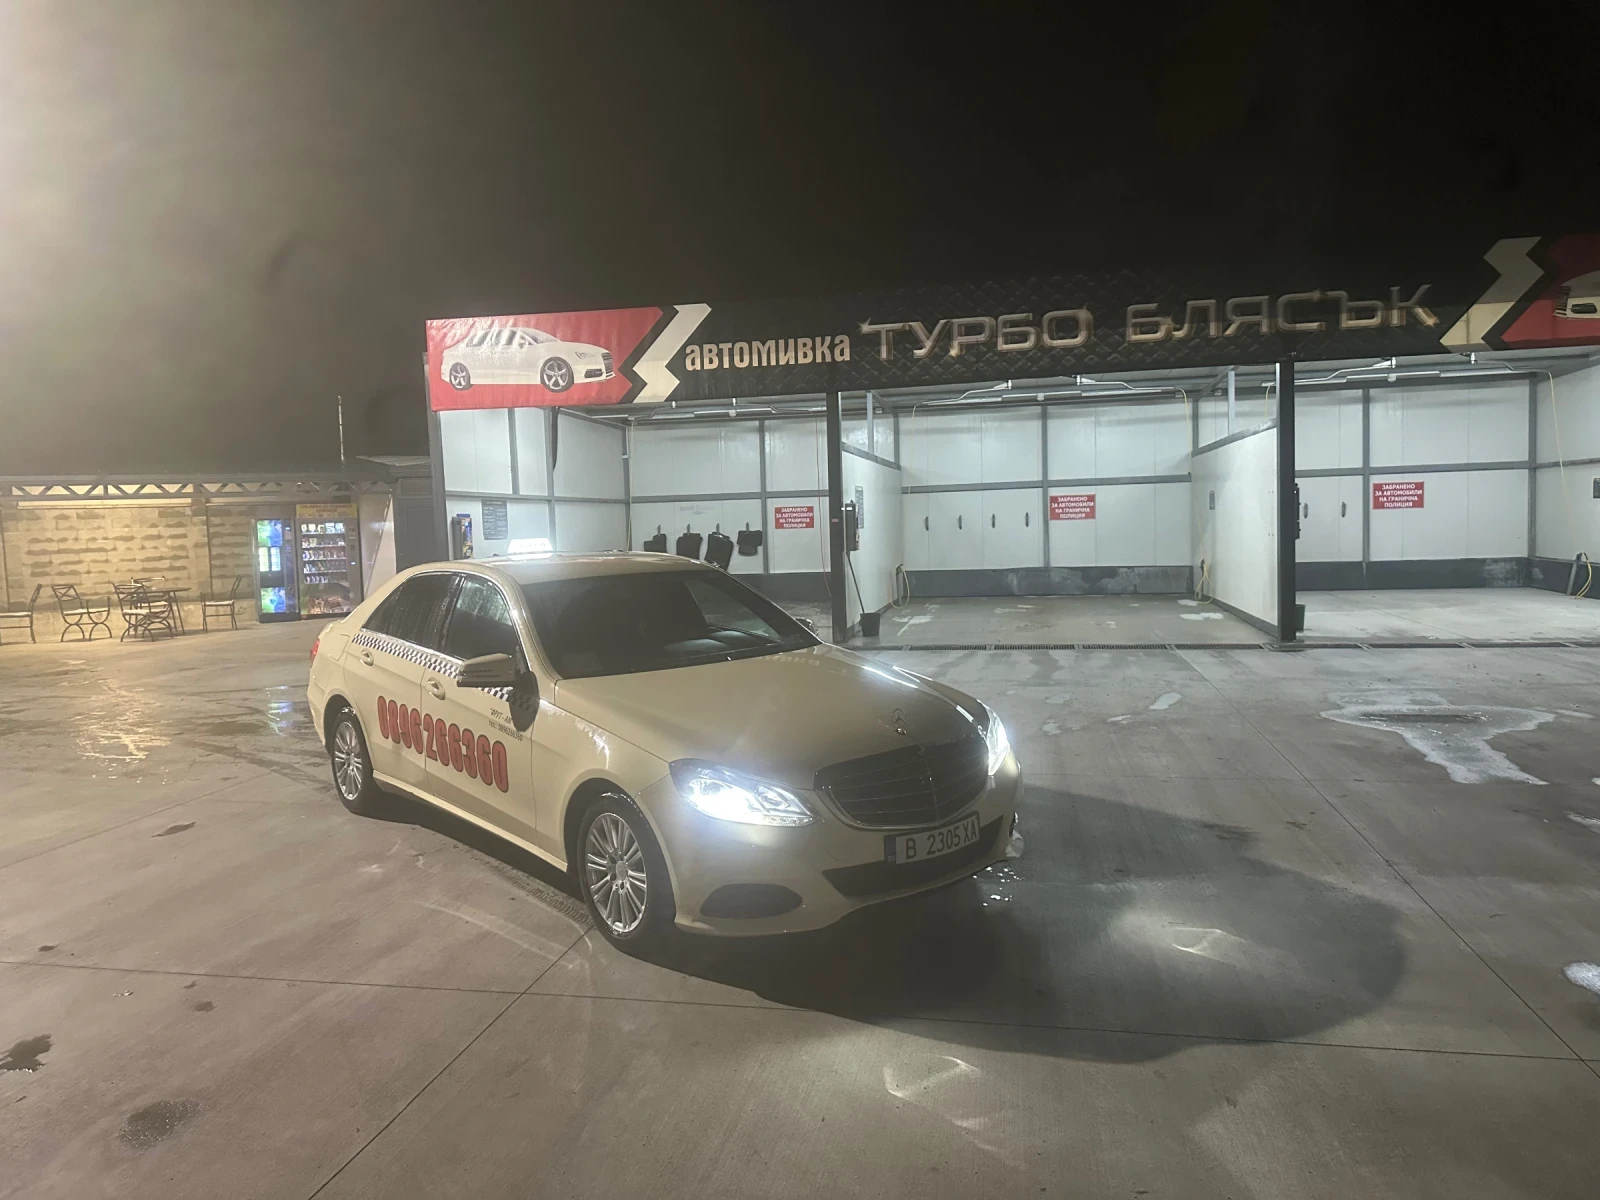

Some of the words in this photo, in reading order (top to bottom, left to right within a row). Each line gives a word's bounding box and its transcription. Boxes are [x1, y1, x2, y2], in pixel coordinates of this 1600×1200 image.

[685, 334, 850, 371] автомивка
[862, 308, 1094, 360] ТУРБО
[1126, 284, 1438, 344] БЛЯСЪК
[377, 695, 509, 793] 0896266360
[926, 826, 961, 856] 2305
